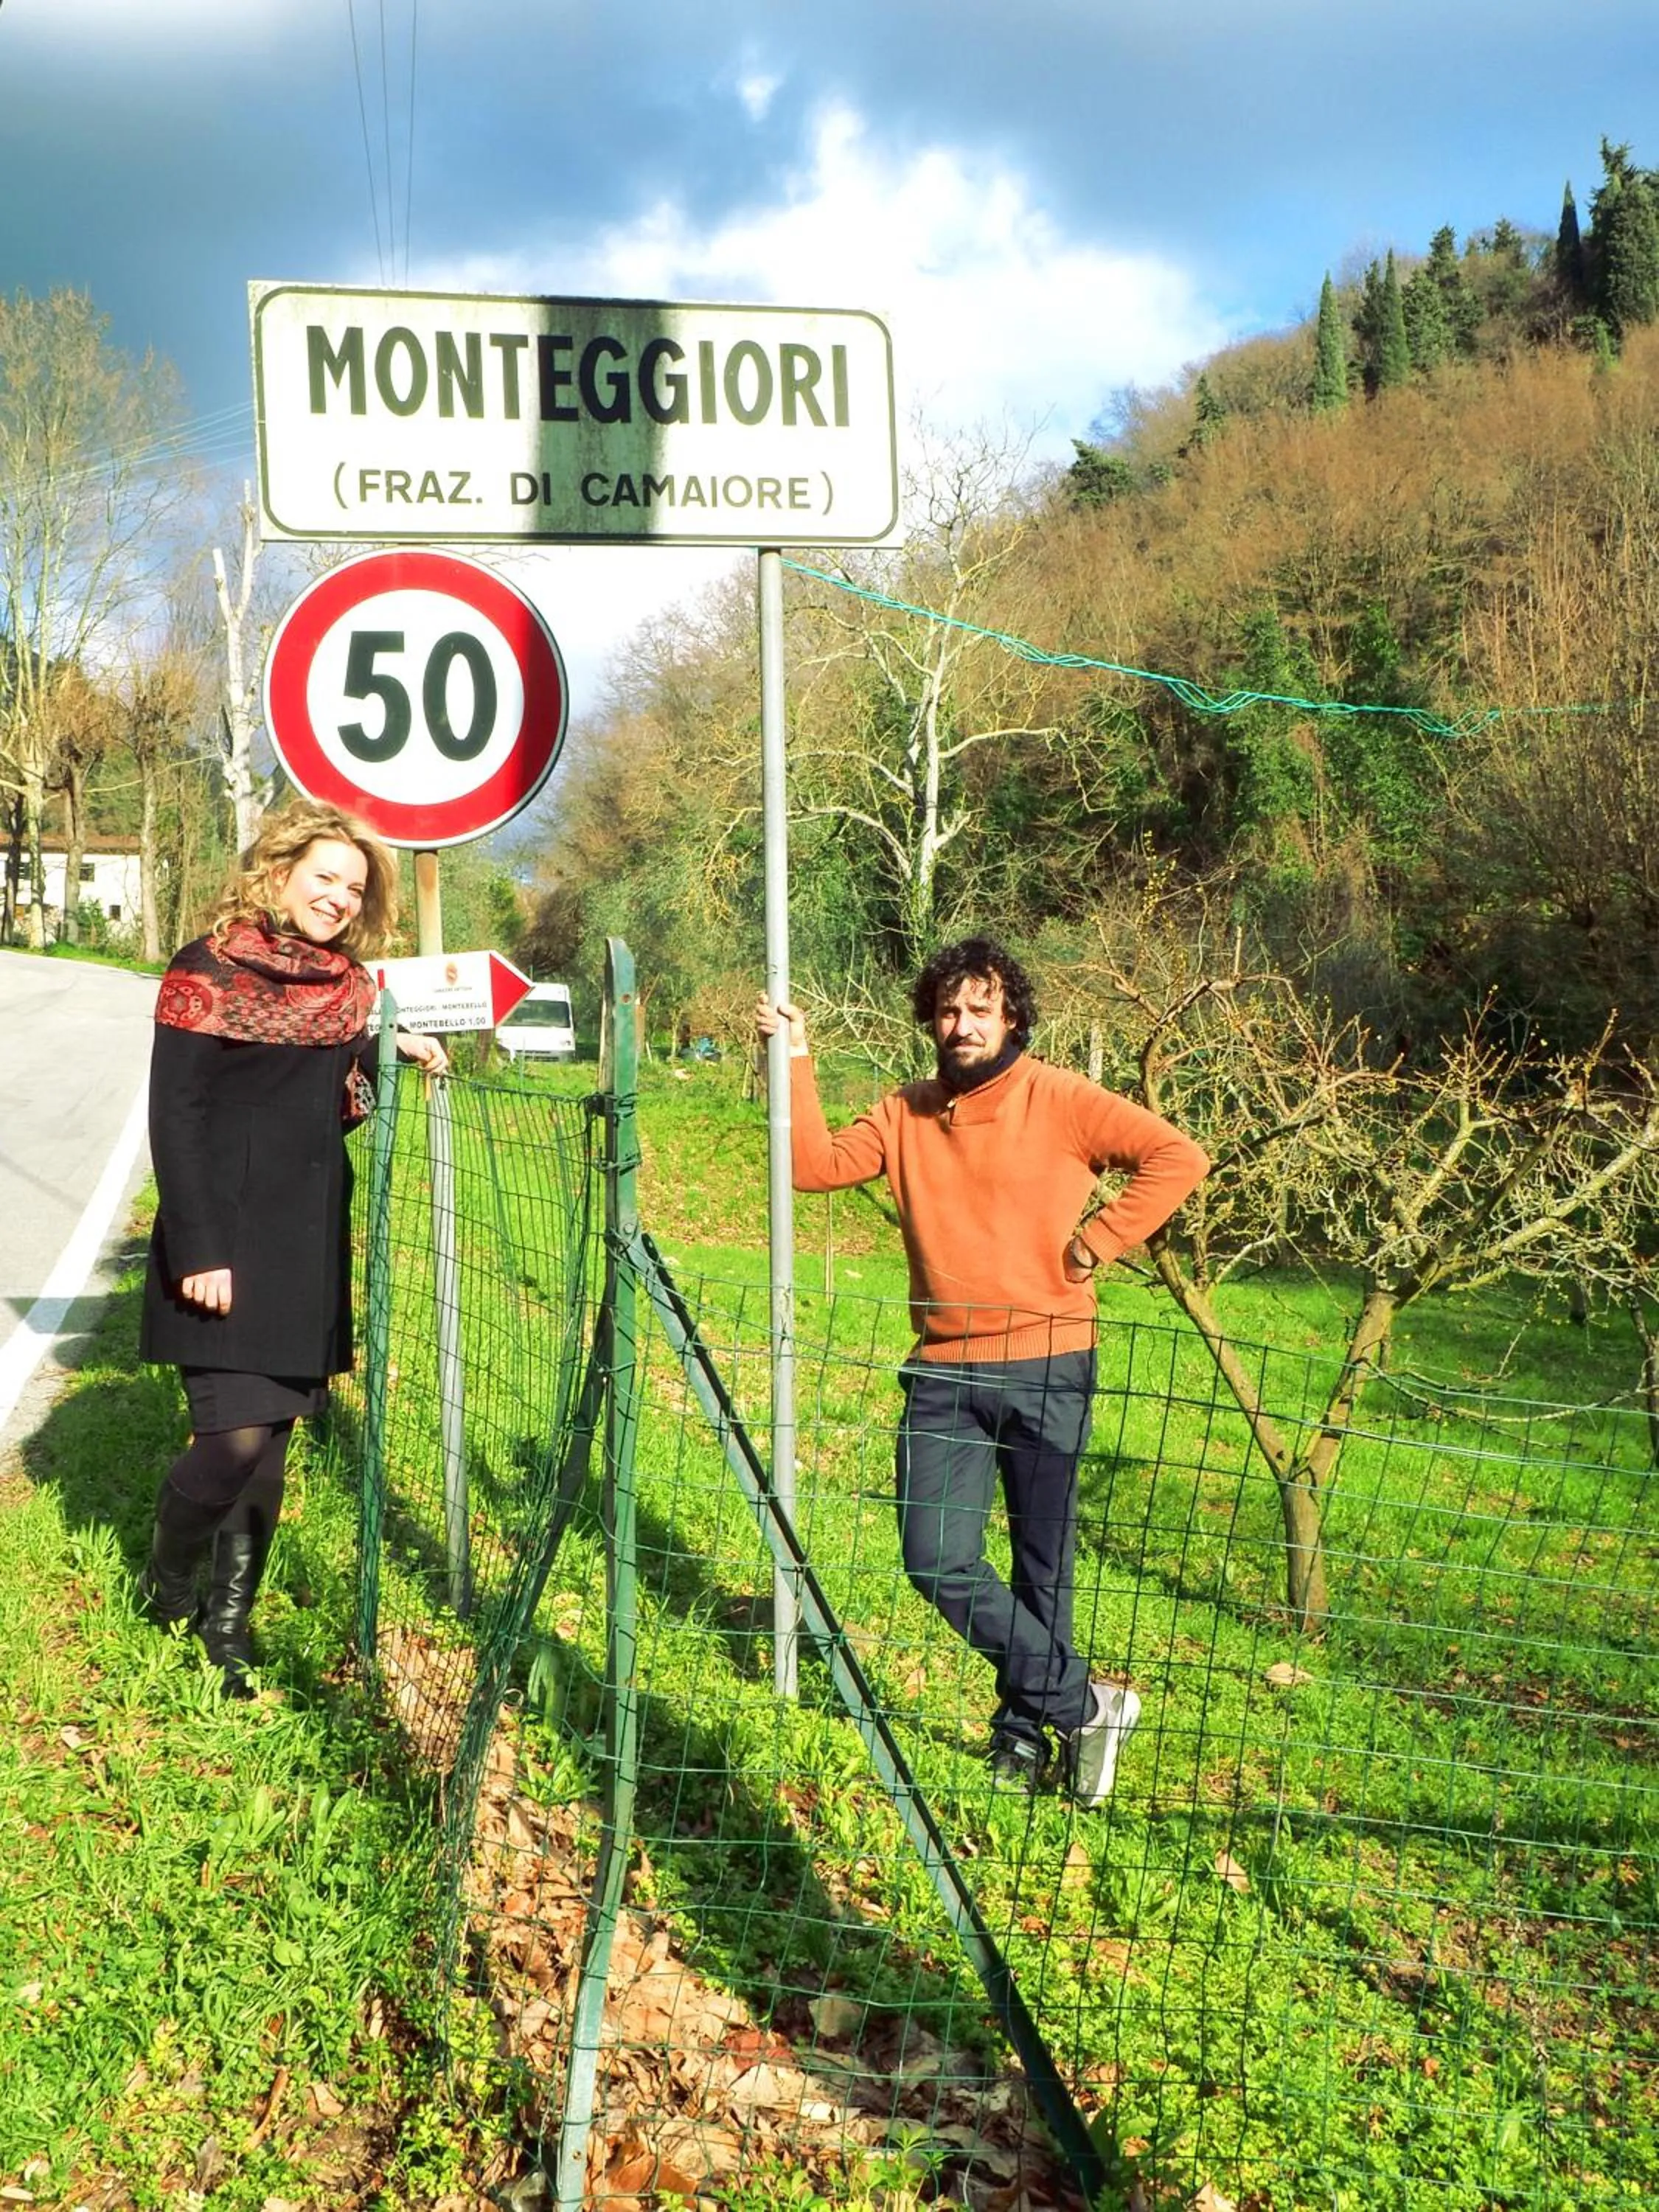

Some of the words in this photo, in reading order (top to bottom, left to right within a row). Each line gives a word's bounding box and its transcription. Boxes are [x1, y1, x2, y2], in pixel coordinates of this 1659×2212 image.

[306, 325, 850, 428] MONTEGGIORI
[333, 462, 484, 510] (FRAZ.
[510, 472, 552, 507] DI
[581, 471, 835, 516] CAMAIORE)
[337, 630, 498, 763] 50
[395, 1003, 437, 1014] ONTEGGIORI
[409, 1018, 467, 1029] MONTEBELLO
